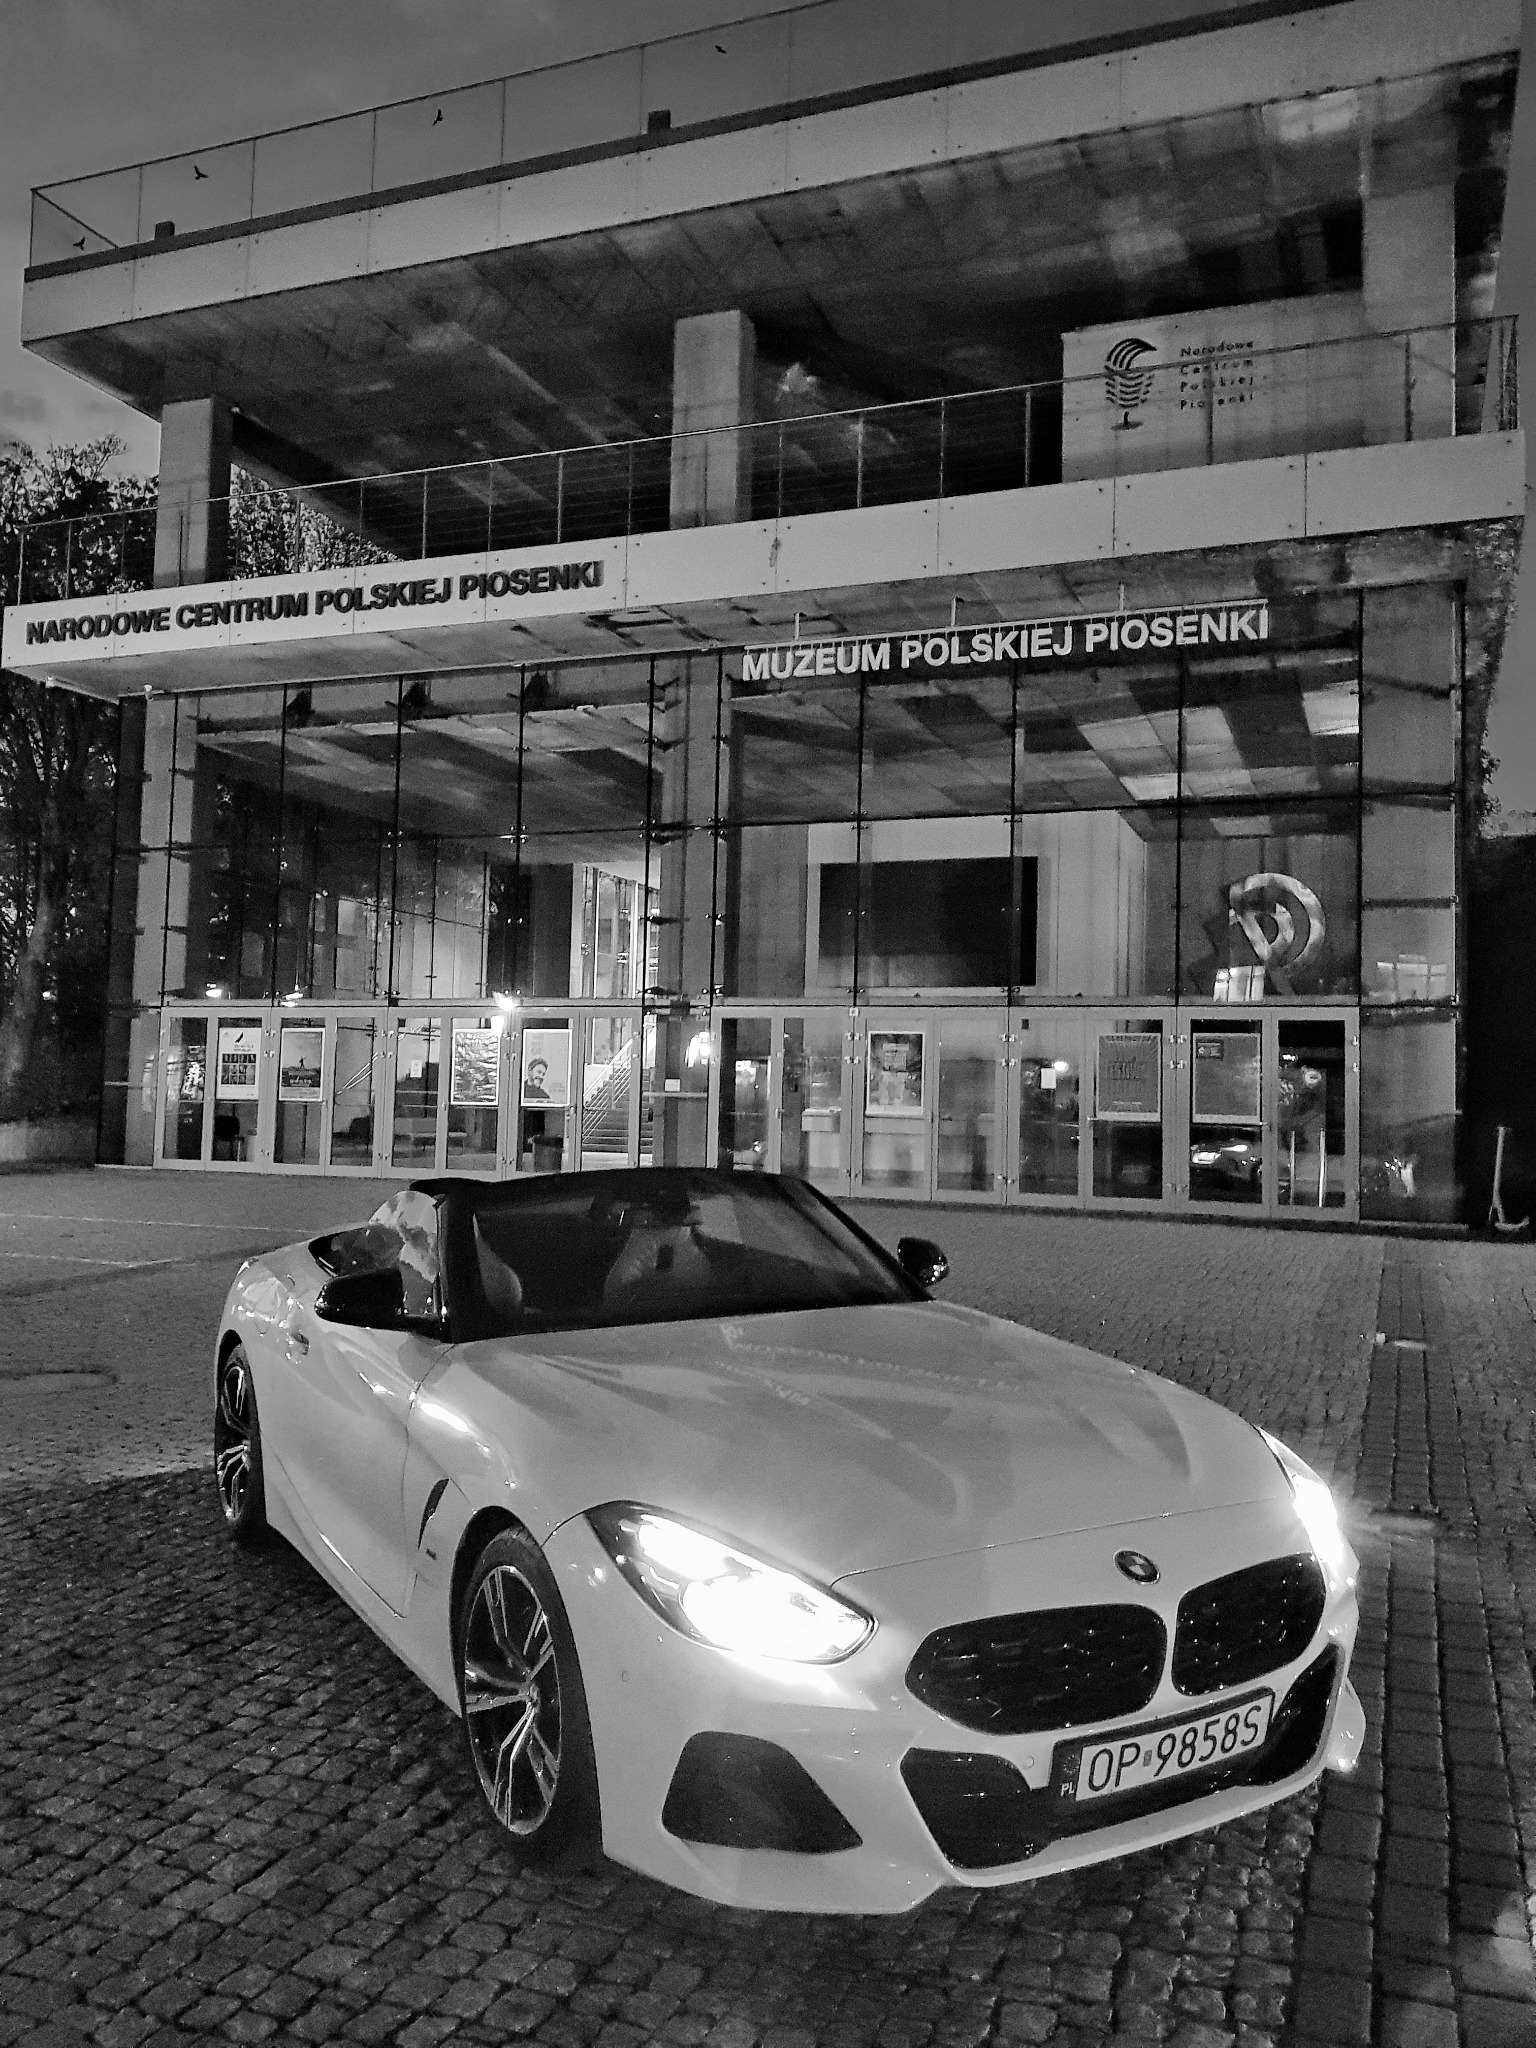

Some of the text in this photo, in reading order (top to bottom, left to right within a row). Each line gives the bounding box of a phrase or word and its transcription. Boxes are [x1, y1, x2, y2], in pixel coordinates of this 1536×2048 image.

[1180, 376, 1254, 393] Polkiej
[1180, 393, 1254, 410] Pioenki
[25, 559, 605, 645] NARODOWE CENTRUM POLSKIEJ PIOSENKI
[742, 608, 1269, 681] MUZEUM POLSKIEJ PIOSENKI
[1087, 1704, 1262, 1792] OP 9858S
[1060, 1781, 1076, 1797] PL
